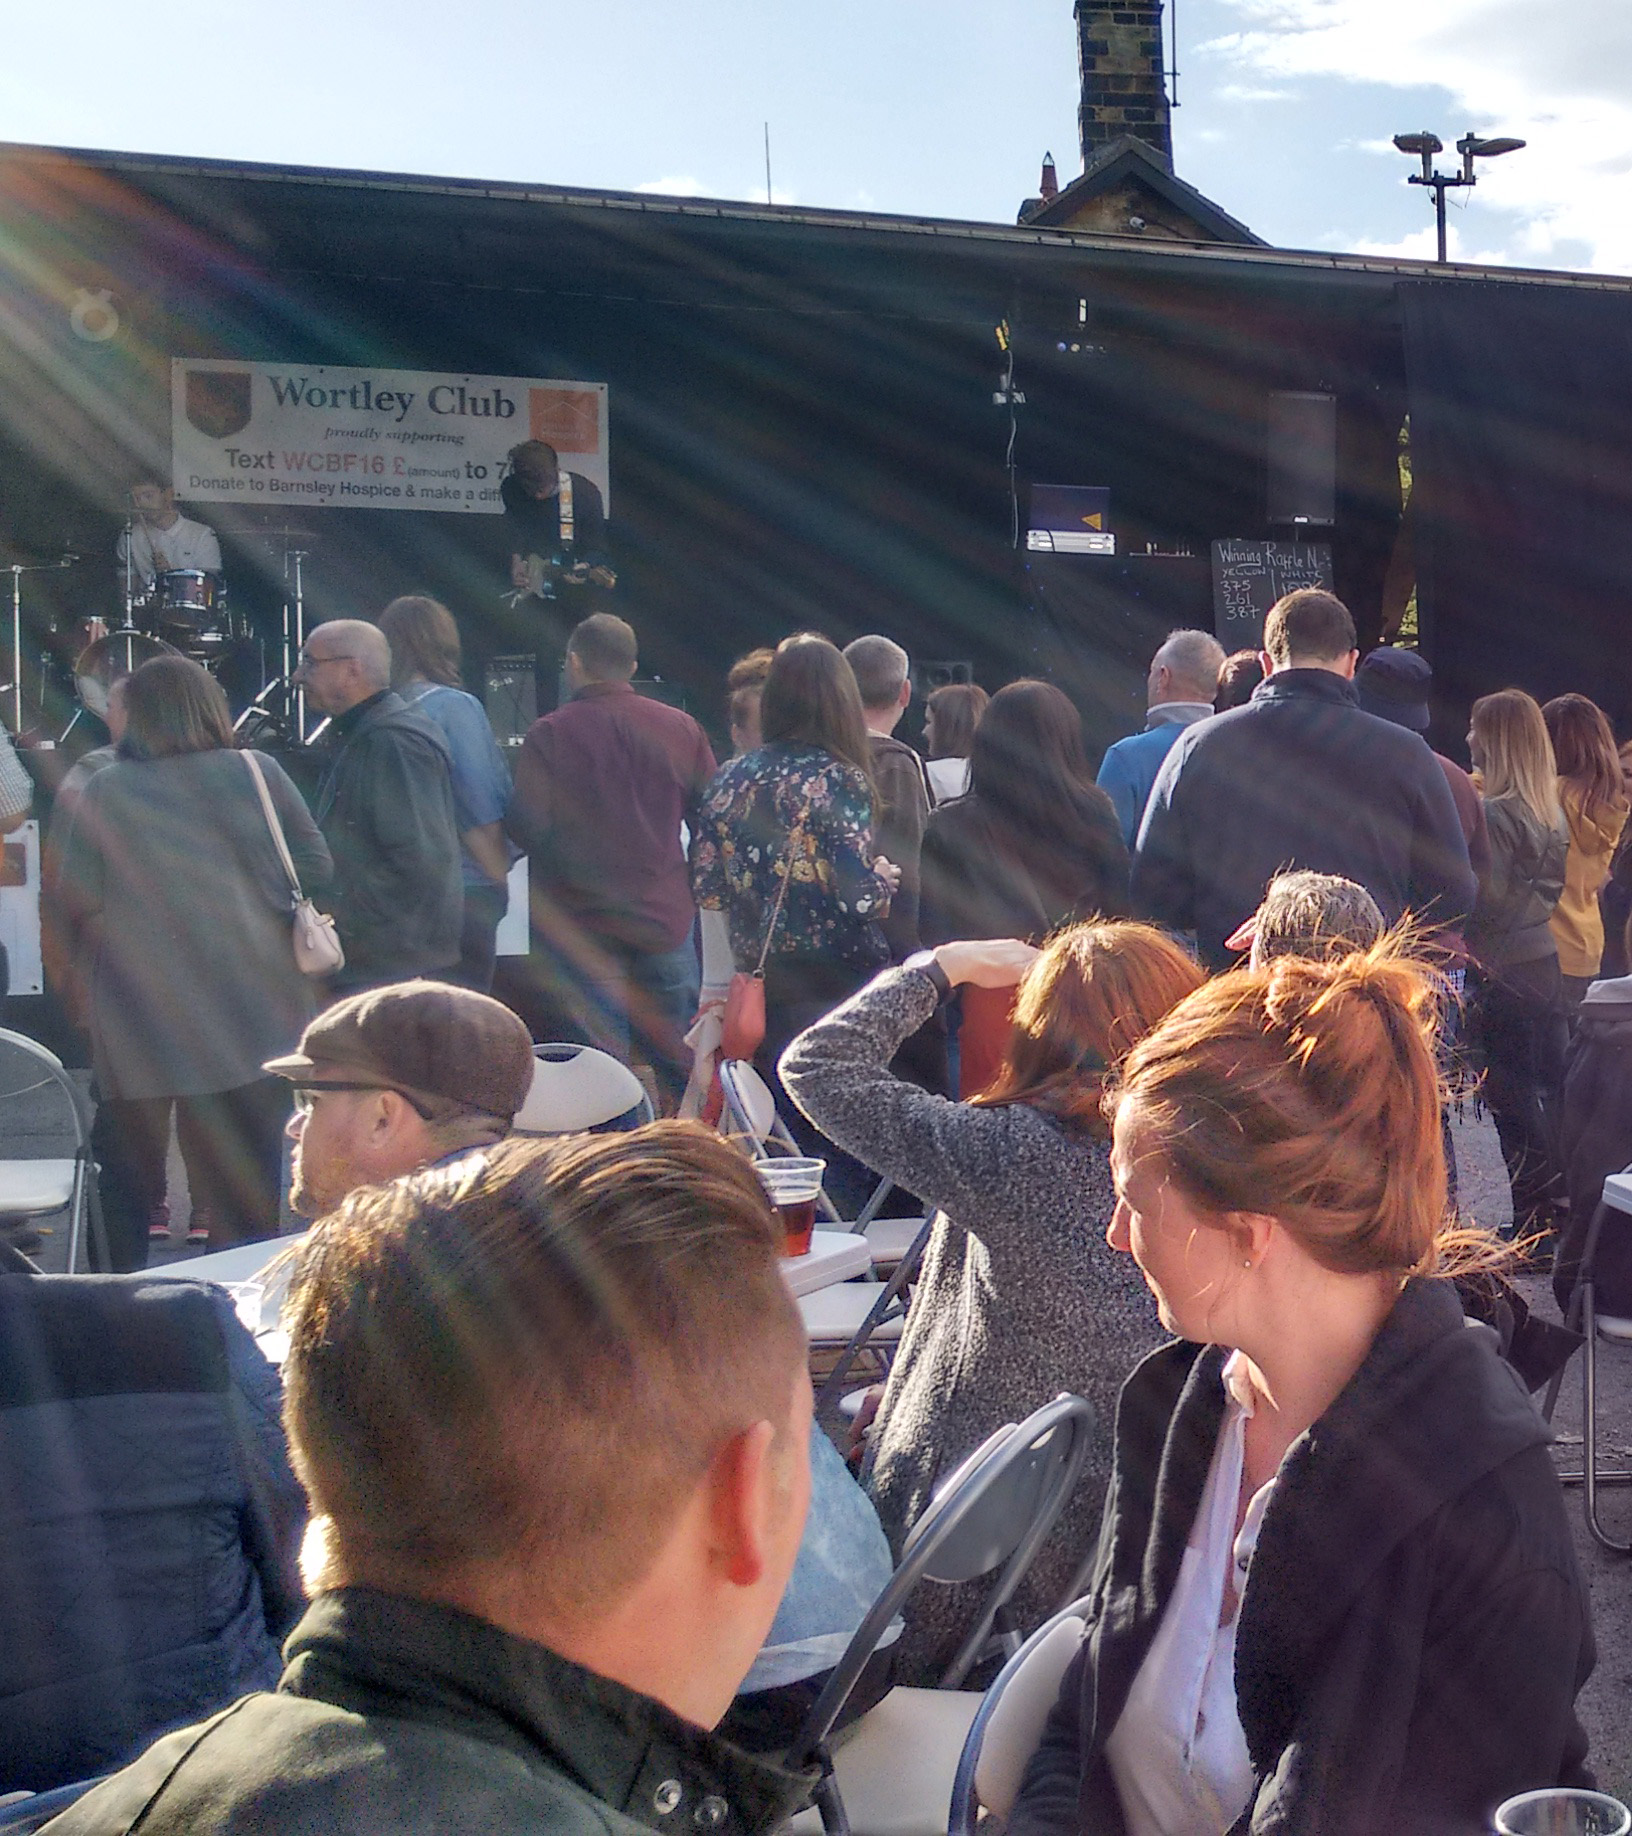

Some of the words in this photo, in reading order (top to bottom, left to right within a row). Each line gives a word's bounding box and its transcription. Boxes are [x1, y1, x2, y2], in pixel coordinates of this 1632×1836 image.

[267, 376, 415, 422] Wortley
[428, 385, 516, 418] Club
[324, 427, 381, 442] proudly
[386, 430, 465, 446] supporting
[225, 449, 275, 469] Text
[283, 451, 385, 475] WCBF16
[393, 456, 406, 477] £
[407, 466, 461, 479] (amount)
[465, 461, 488, 479] to
[190, 475, 245, 490] Donate
[249, 477, 265, 491] to
[269, 479, 335, 497] Barnsley
[340, 481, 400, 498] Hospice
[405, 484, 415, 497] &
[421, 486, 461, 500] make
[466, 489, 475, 500] a
[1218, 542, 1261, 567] Winning
[1261, 541, 1304, 570] Raffle
[1222, 567, 1266, 578] YELLOW
[1281, 569, 1323, 579] WHITE
[1220, 580, 1251, 594] 375
[1224, 592, 1251, 605] 261
[1226, 605, 1260, 620] 387
